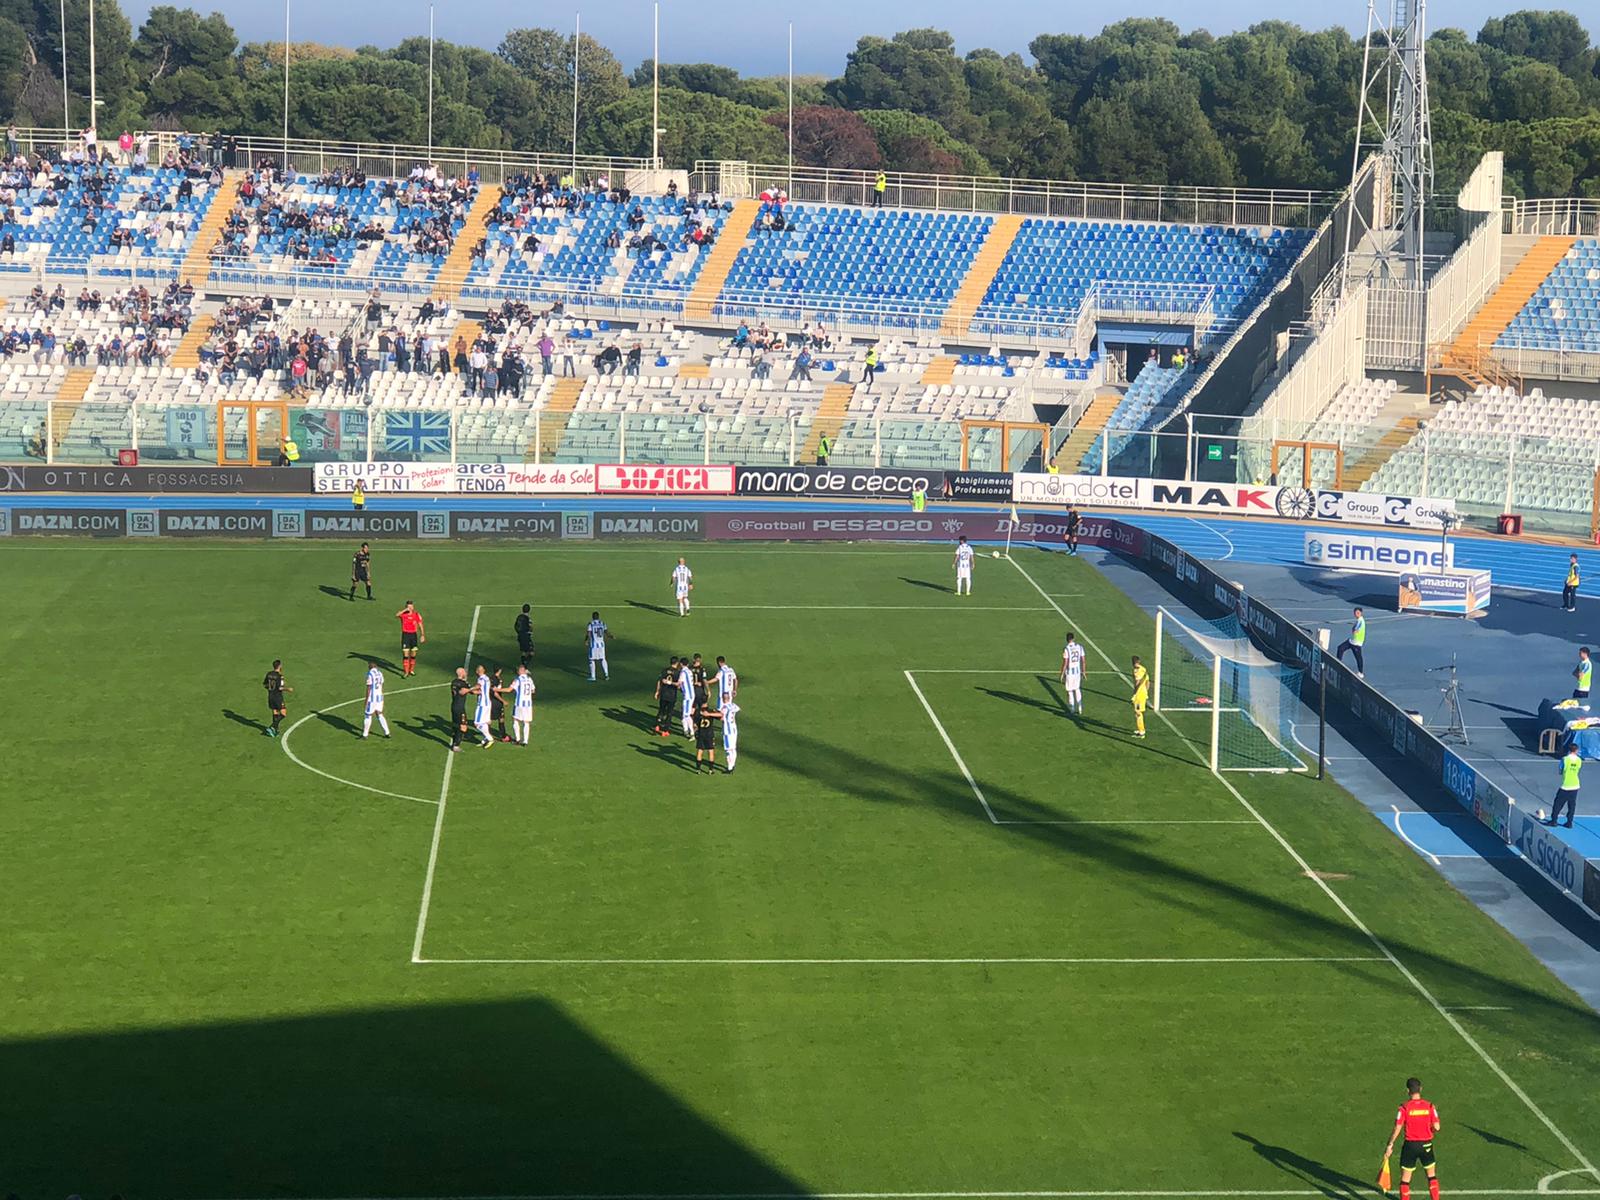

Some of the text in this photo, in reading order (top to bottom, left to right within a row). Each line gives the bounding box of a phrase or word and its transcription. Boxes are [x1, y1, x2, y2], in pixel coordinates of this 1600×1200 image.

[323, 464, 405, 476] GRUPPO
[457, 463, 505, 474] area
[44, 471, 132, 486] OTTICA
[147, 473, 244, 486] FOSSACESIA
[507, 468, 594, 485] Tende da Sole
[738, 470, 929, 493] mario de cecco
[954, 476, 1013, 486] Abbigliamento
[456, 478, 506, 491] TENDA
[954, 485, 1011, 495] Professionale
[1152, 484, 1274, 510] MAK
[1347, 500, 1380, 515] Group
[19, 514, 119, 530] DAZN.COM
[167, 516, 266, 530] DAZN.COM
[312, 517, 411, 531] DAZN.COM
[601, 519, 698, 532] DAZN.COM
[1327, 541, 1449, 567] simeone
[1446, 759, 1473, 801] 18:05
